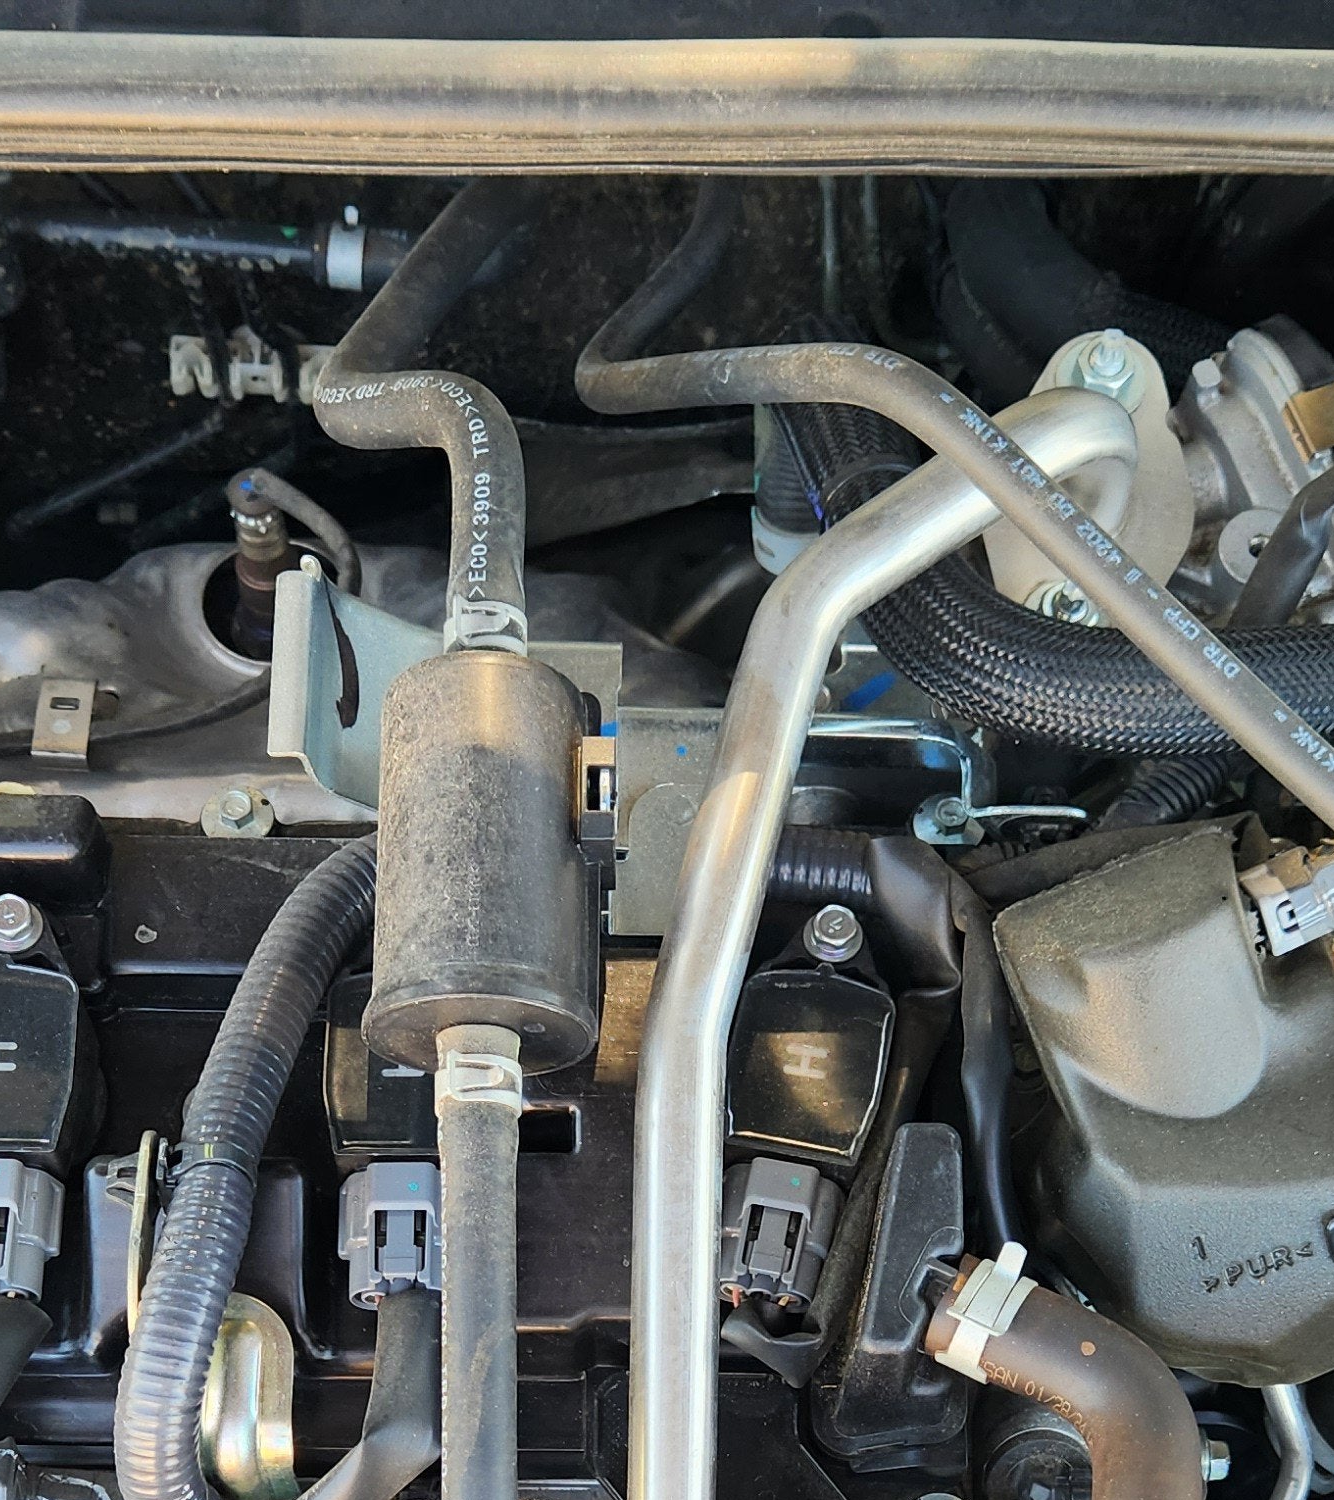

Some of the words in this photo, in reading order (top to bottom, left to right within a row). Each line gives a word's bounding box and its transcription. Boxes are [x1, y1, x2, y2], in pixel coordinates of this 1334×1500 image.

[960, 407, 1008, 454] KINK
[1202, 646, 1242, 679] DTR
[1190, 1235, 1208, 1261] 1
[981, 1361, 1019, 1389] SAN
